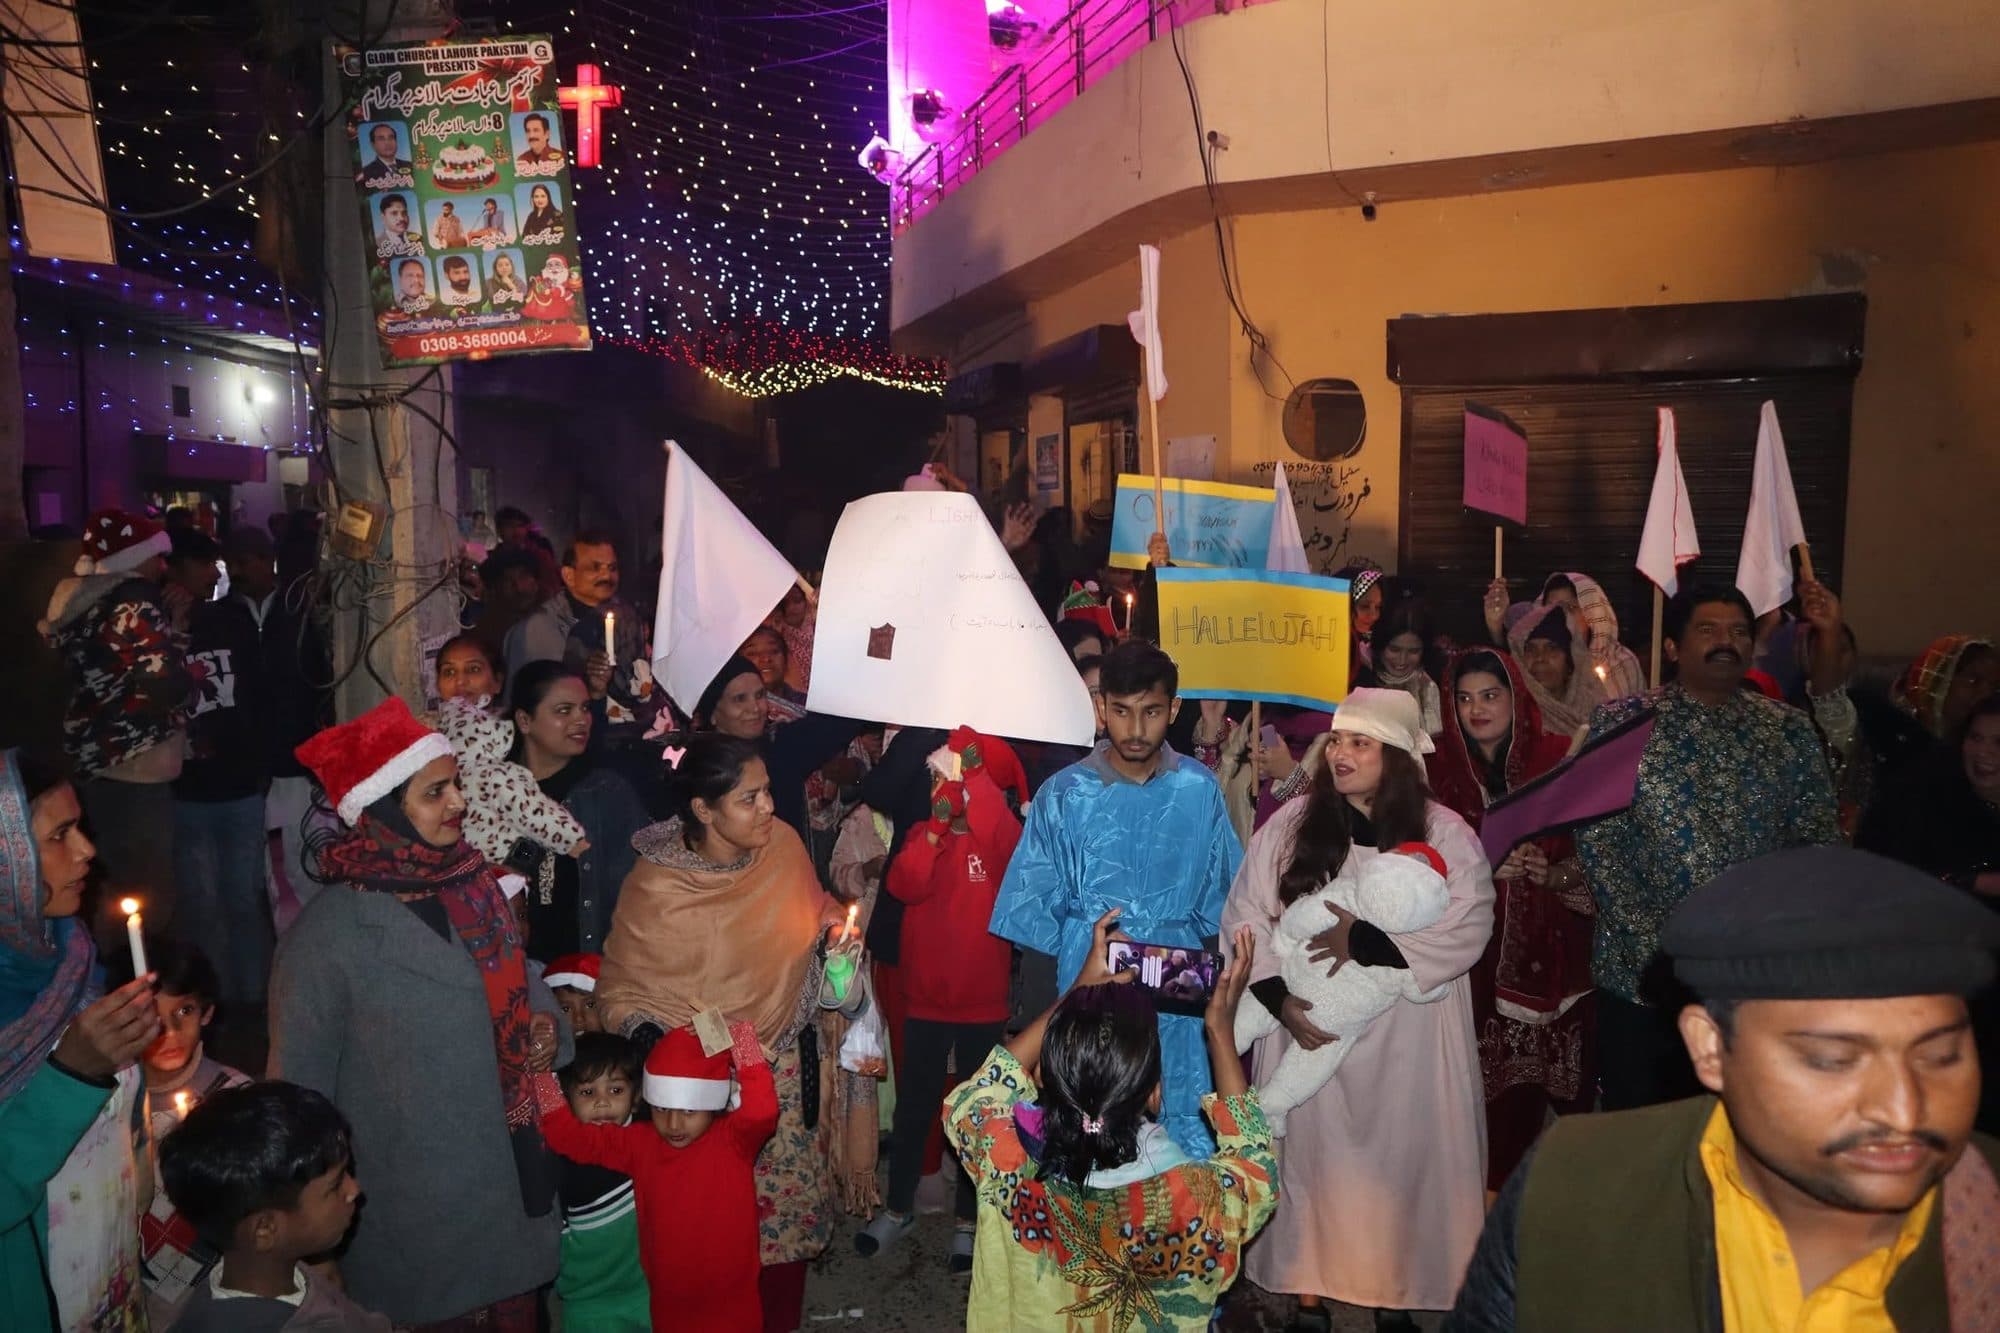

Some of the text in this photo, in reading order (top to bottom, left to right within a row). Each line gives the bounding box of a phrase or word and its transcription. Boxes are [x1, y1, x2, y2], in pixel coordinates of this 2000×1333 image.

[366, 51, 396, 65] GLOM
[398, 48, 440, 63] CHURCH
[441, 45, 480, 60] LAHORE
[426, 60, 477, 74] PRESENTS
[362, 72, 413, 120] پروگرام
[452, 79, 497, 107] عبادت
[412, 108, 447, 144] پروگرام
[492, 113, 503, 130] 8
[420, 329, 528, 353] 0308-3680004
[1173, 605, 1337, 652] HALLELUJAH
